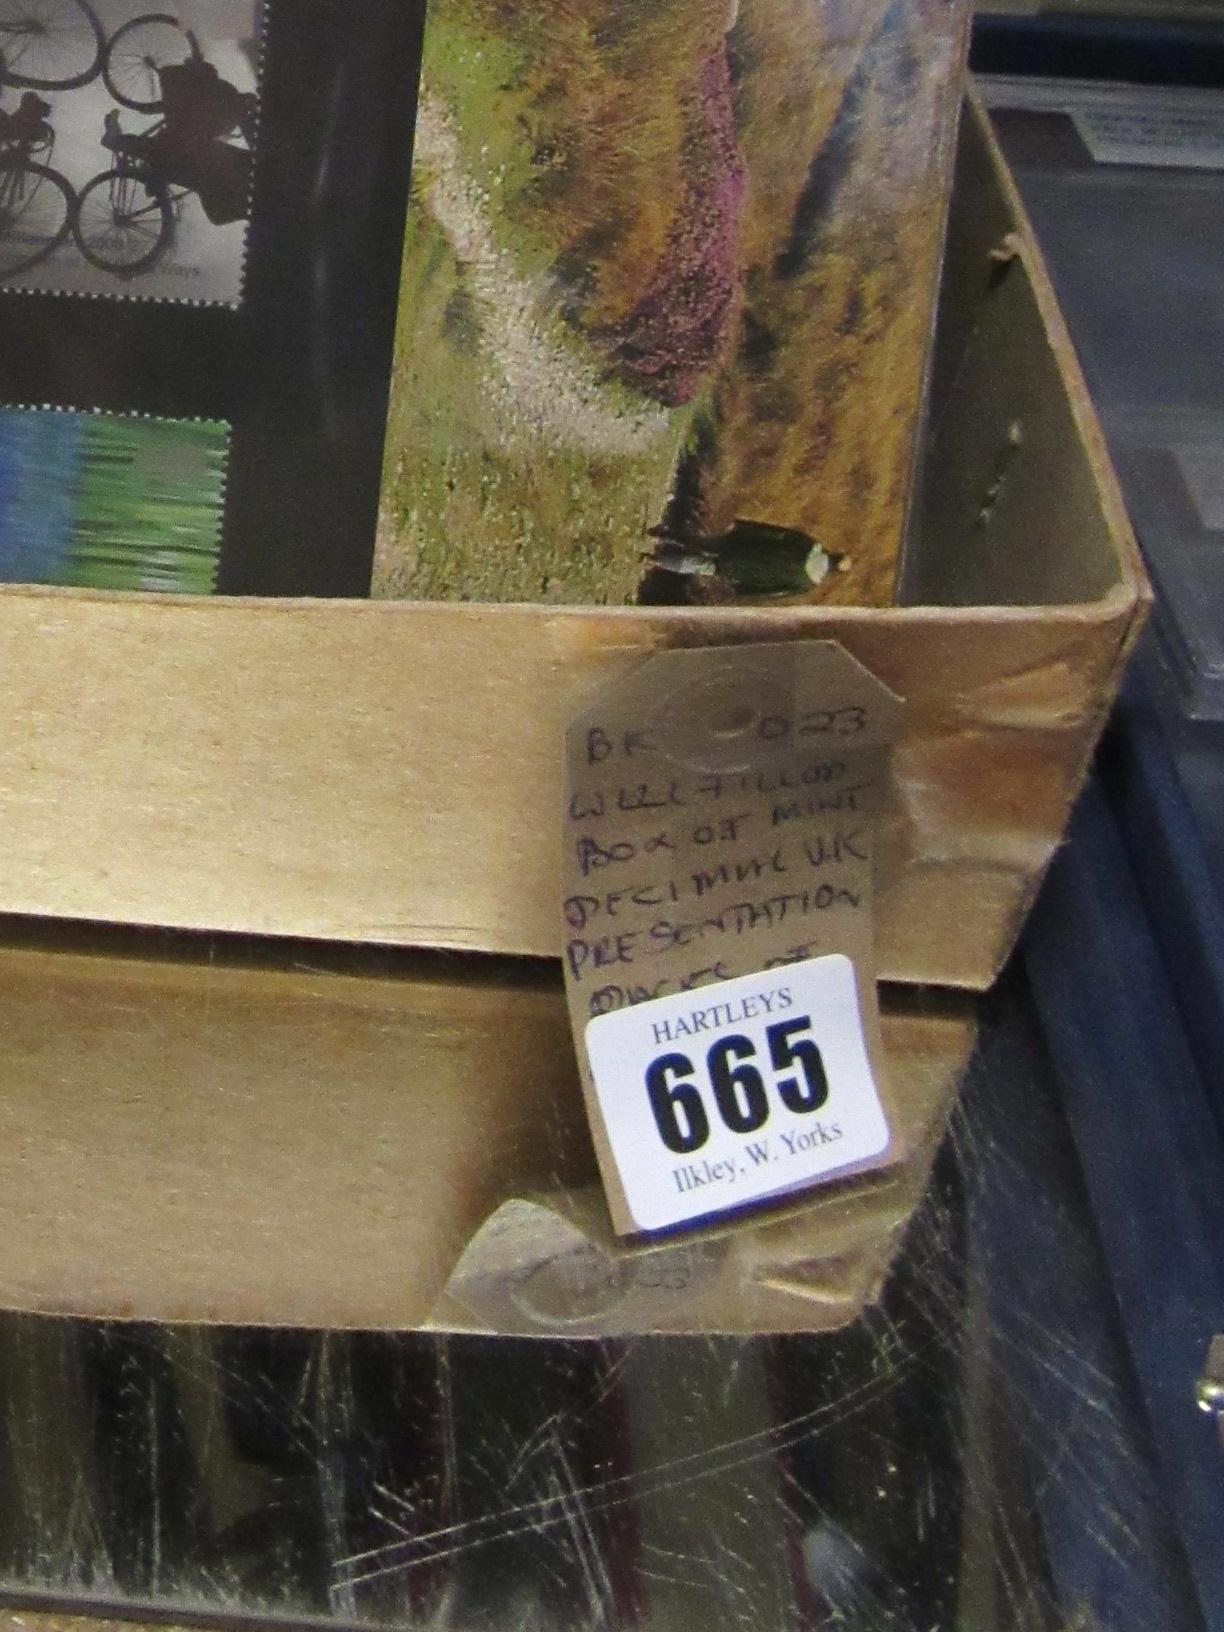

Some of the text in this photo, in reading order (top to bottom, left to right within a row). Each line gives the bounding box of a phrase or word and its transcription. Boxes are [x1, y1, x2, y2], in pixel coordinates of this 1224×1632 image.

[651, 986, 794, 1045] HARTLEYS
[644, 1014, 829, 1155] 665
[744, 1140, 780, 1167] W.
[779, 1121, 845, 1156] Yorks
